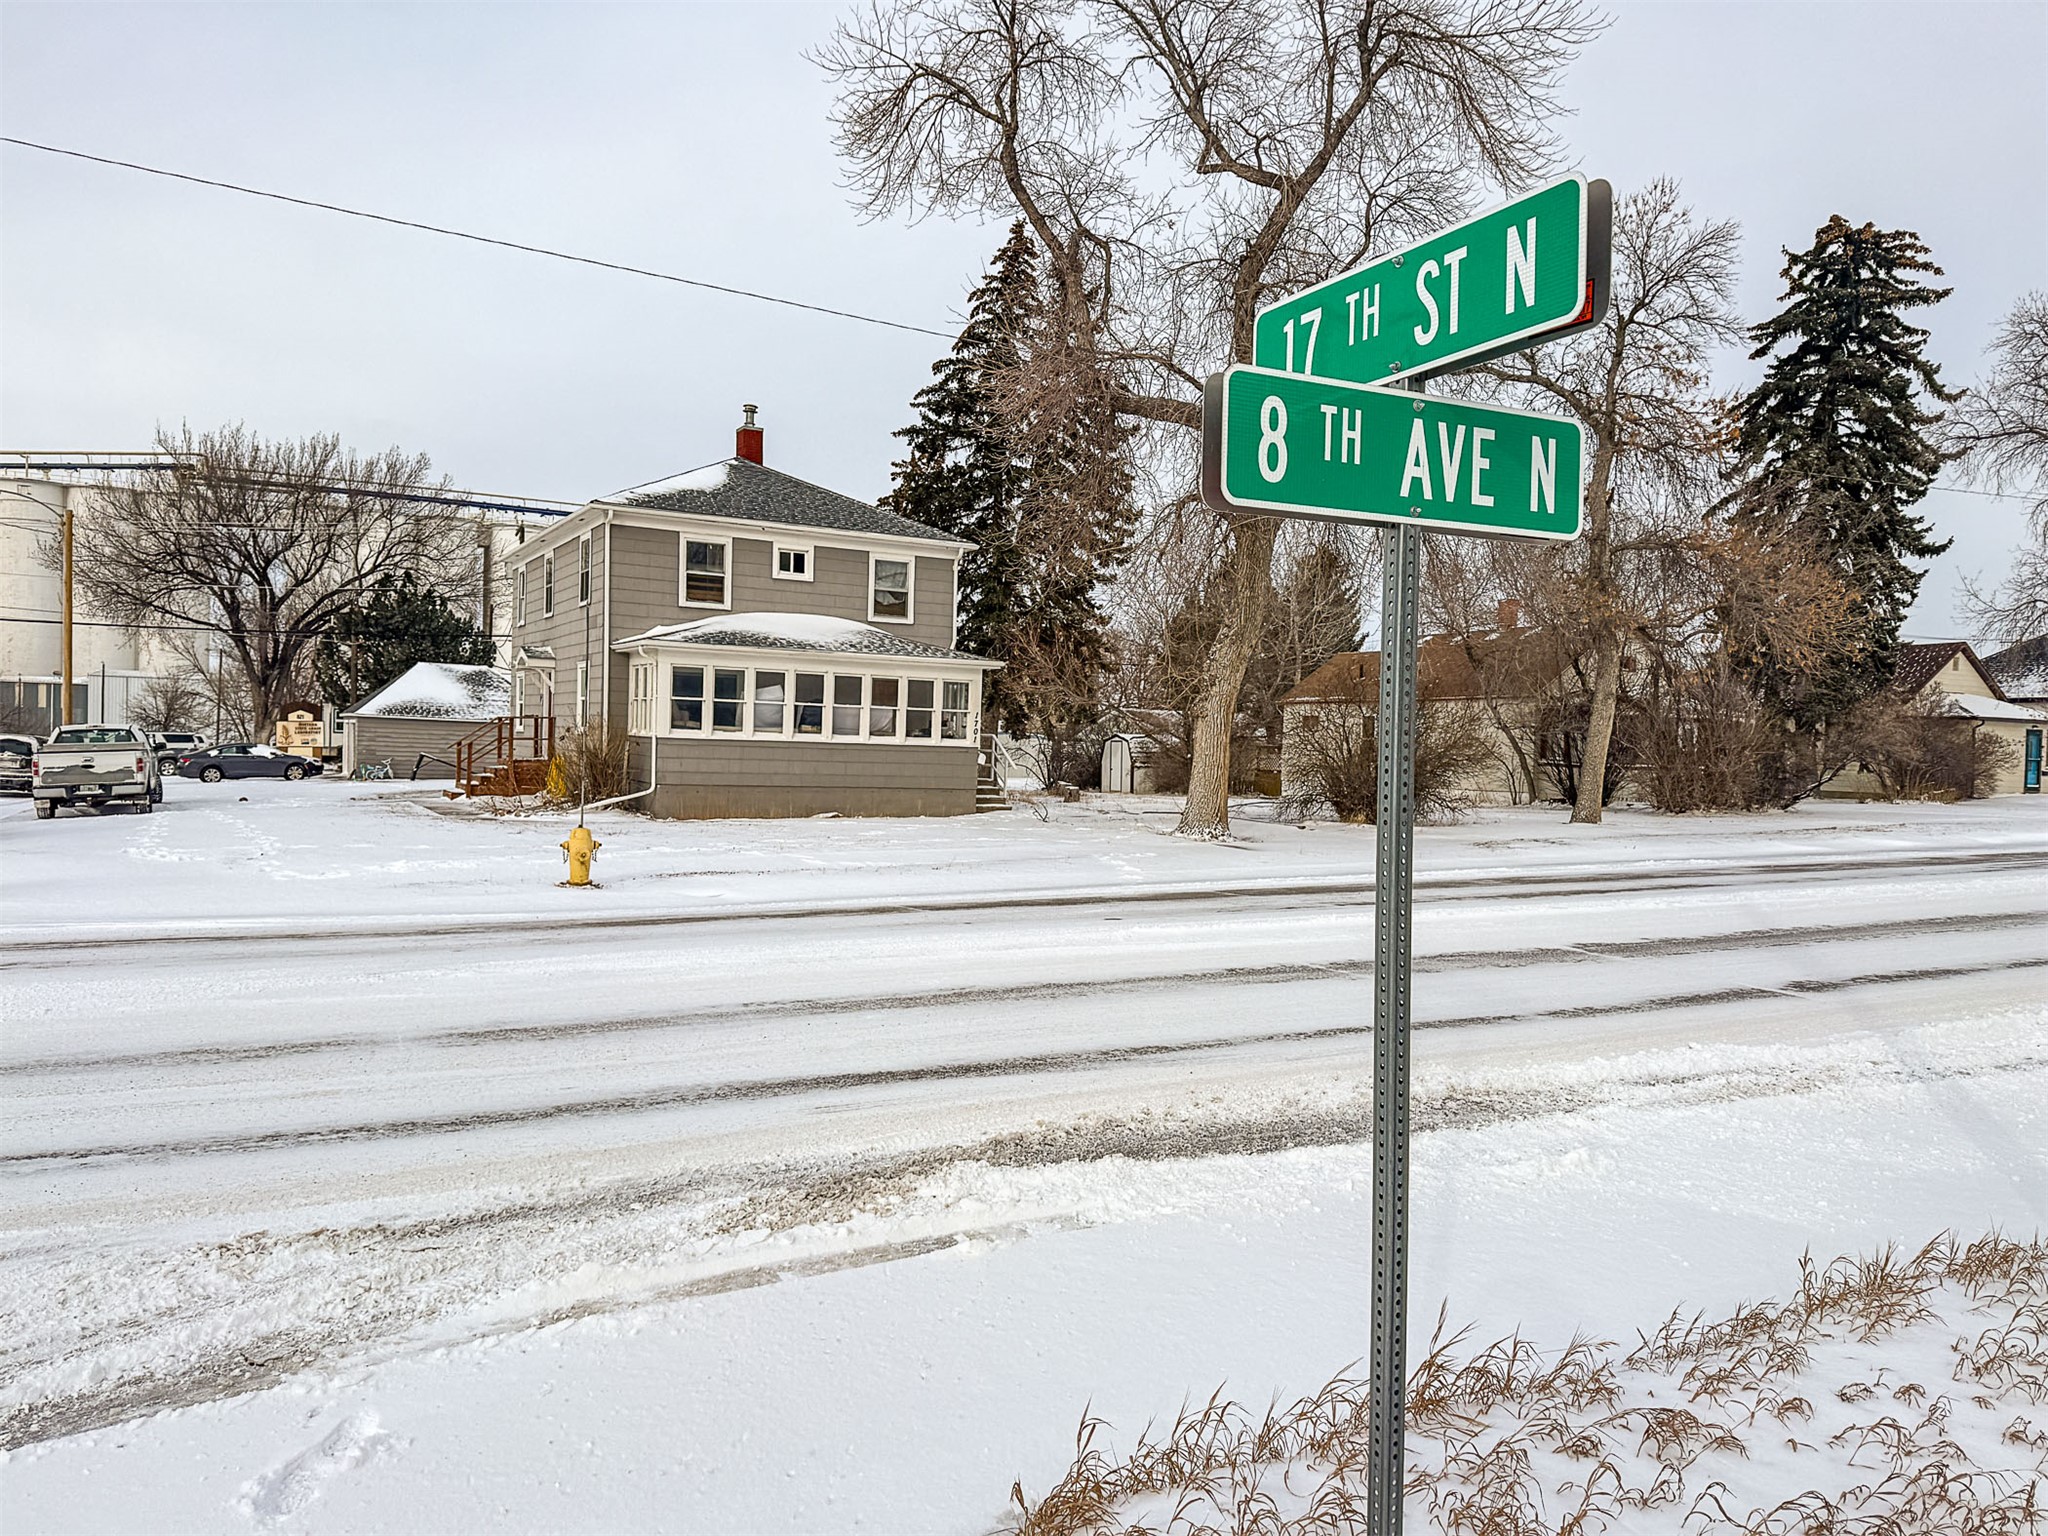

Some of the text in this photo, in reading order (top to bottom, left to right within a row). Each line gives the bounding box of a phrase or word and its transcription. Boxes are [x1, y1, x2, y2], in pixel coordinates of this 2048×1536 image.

[1282, 306, 1323, 376] 17
[1345, 283, 1380, 347] TH
[1413, 245, 1468, 347] ST
[1505, 216, 1537, 315] N
[1257, 395, 1557, 514] 8 TH AVE N
